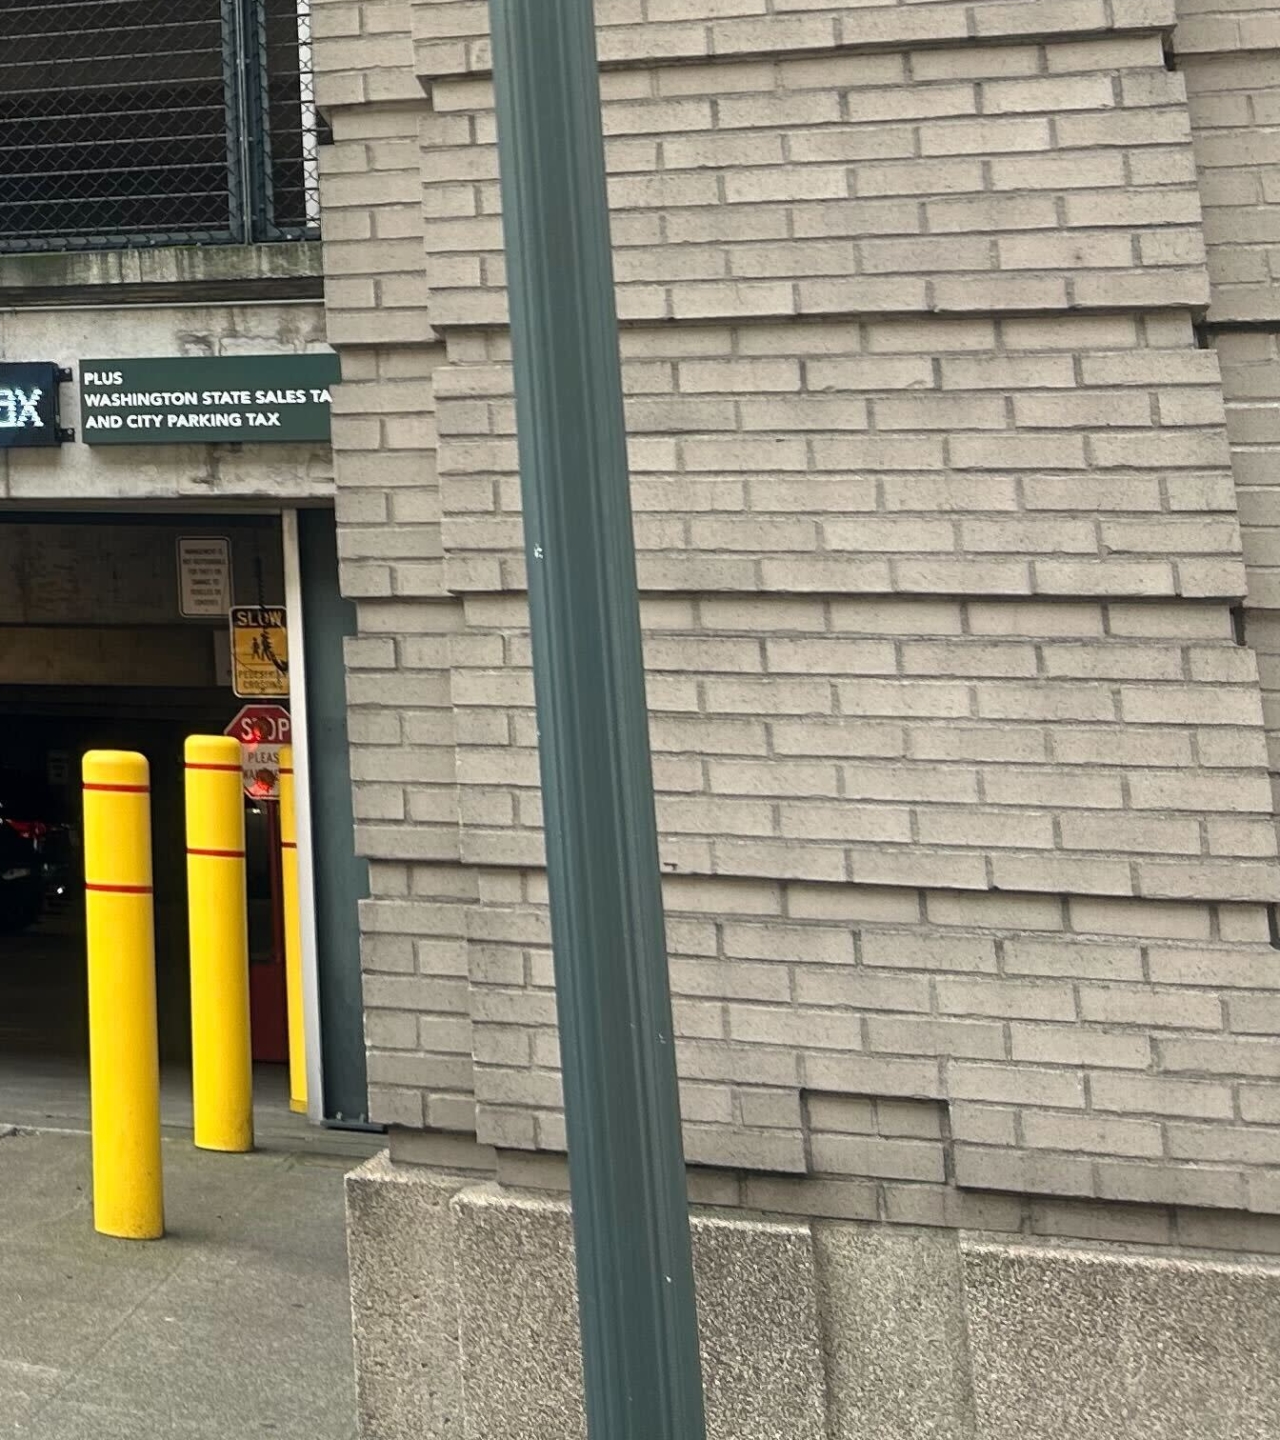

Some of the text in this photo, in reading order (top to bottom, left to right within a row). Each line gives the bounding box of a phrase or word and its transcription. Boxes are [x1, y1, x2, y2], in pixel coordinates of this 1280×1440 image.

[83, 371, 123, 386] PLUS
[83, 389, 333, 407] WASHINGTON STATE SALES TA
[85, 412, 281, 429] AND CITY PARKING TAX
[240, 716, 290, 741] SOP
[248, 751, 280, 764] PLEAS
